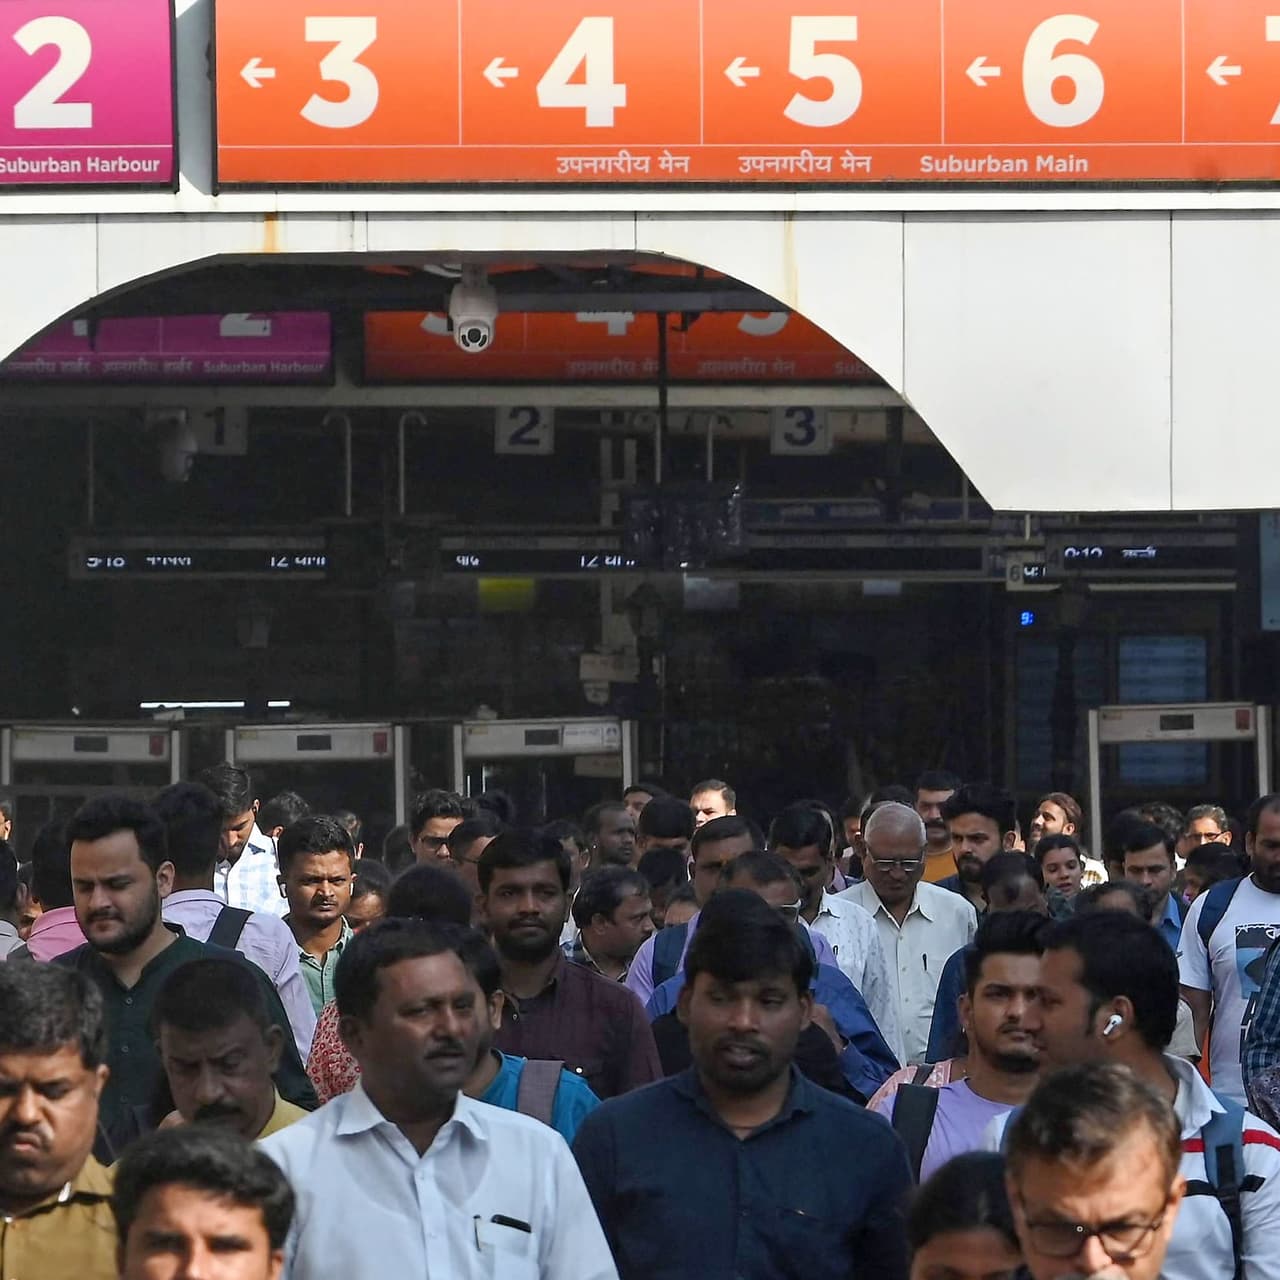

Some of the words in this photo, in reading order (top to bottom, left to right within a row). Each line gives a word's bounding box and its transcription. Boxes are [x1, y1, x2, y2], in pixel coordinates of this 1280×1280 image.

[13, 16, 92, 128] 2
[301, 16, 379, 128] 3
[536, 16, 626, 127] 4
[784, 16, 862, 127] 5
[1023, 14, 1104, 127] 6
[0, 156, 81, 172] Suburban
[87, 156, 160, 172] Harbour
[557, 149, 649, 174] उपनगरीय
[657, 149, 690, 173] मेन
[738, 149, 832, 174] उपनगरीय
[840, 149, 872, 173] मेन
[920, 155, 1028, 173] Suburban
[1036, 155, 1089, 173] Main
[204, 361, 266, 373] Suburban
[270, 361, 324, 373] Harbour
[508, 405, 545, 446] 2
[783, 406, 816, 446] 3
